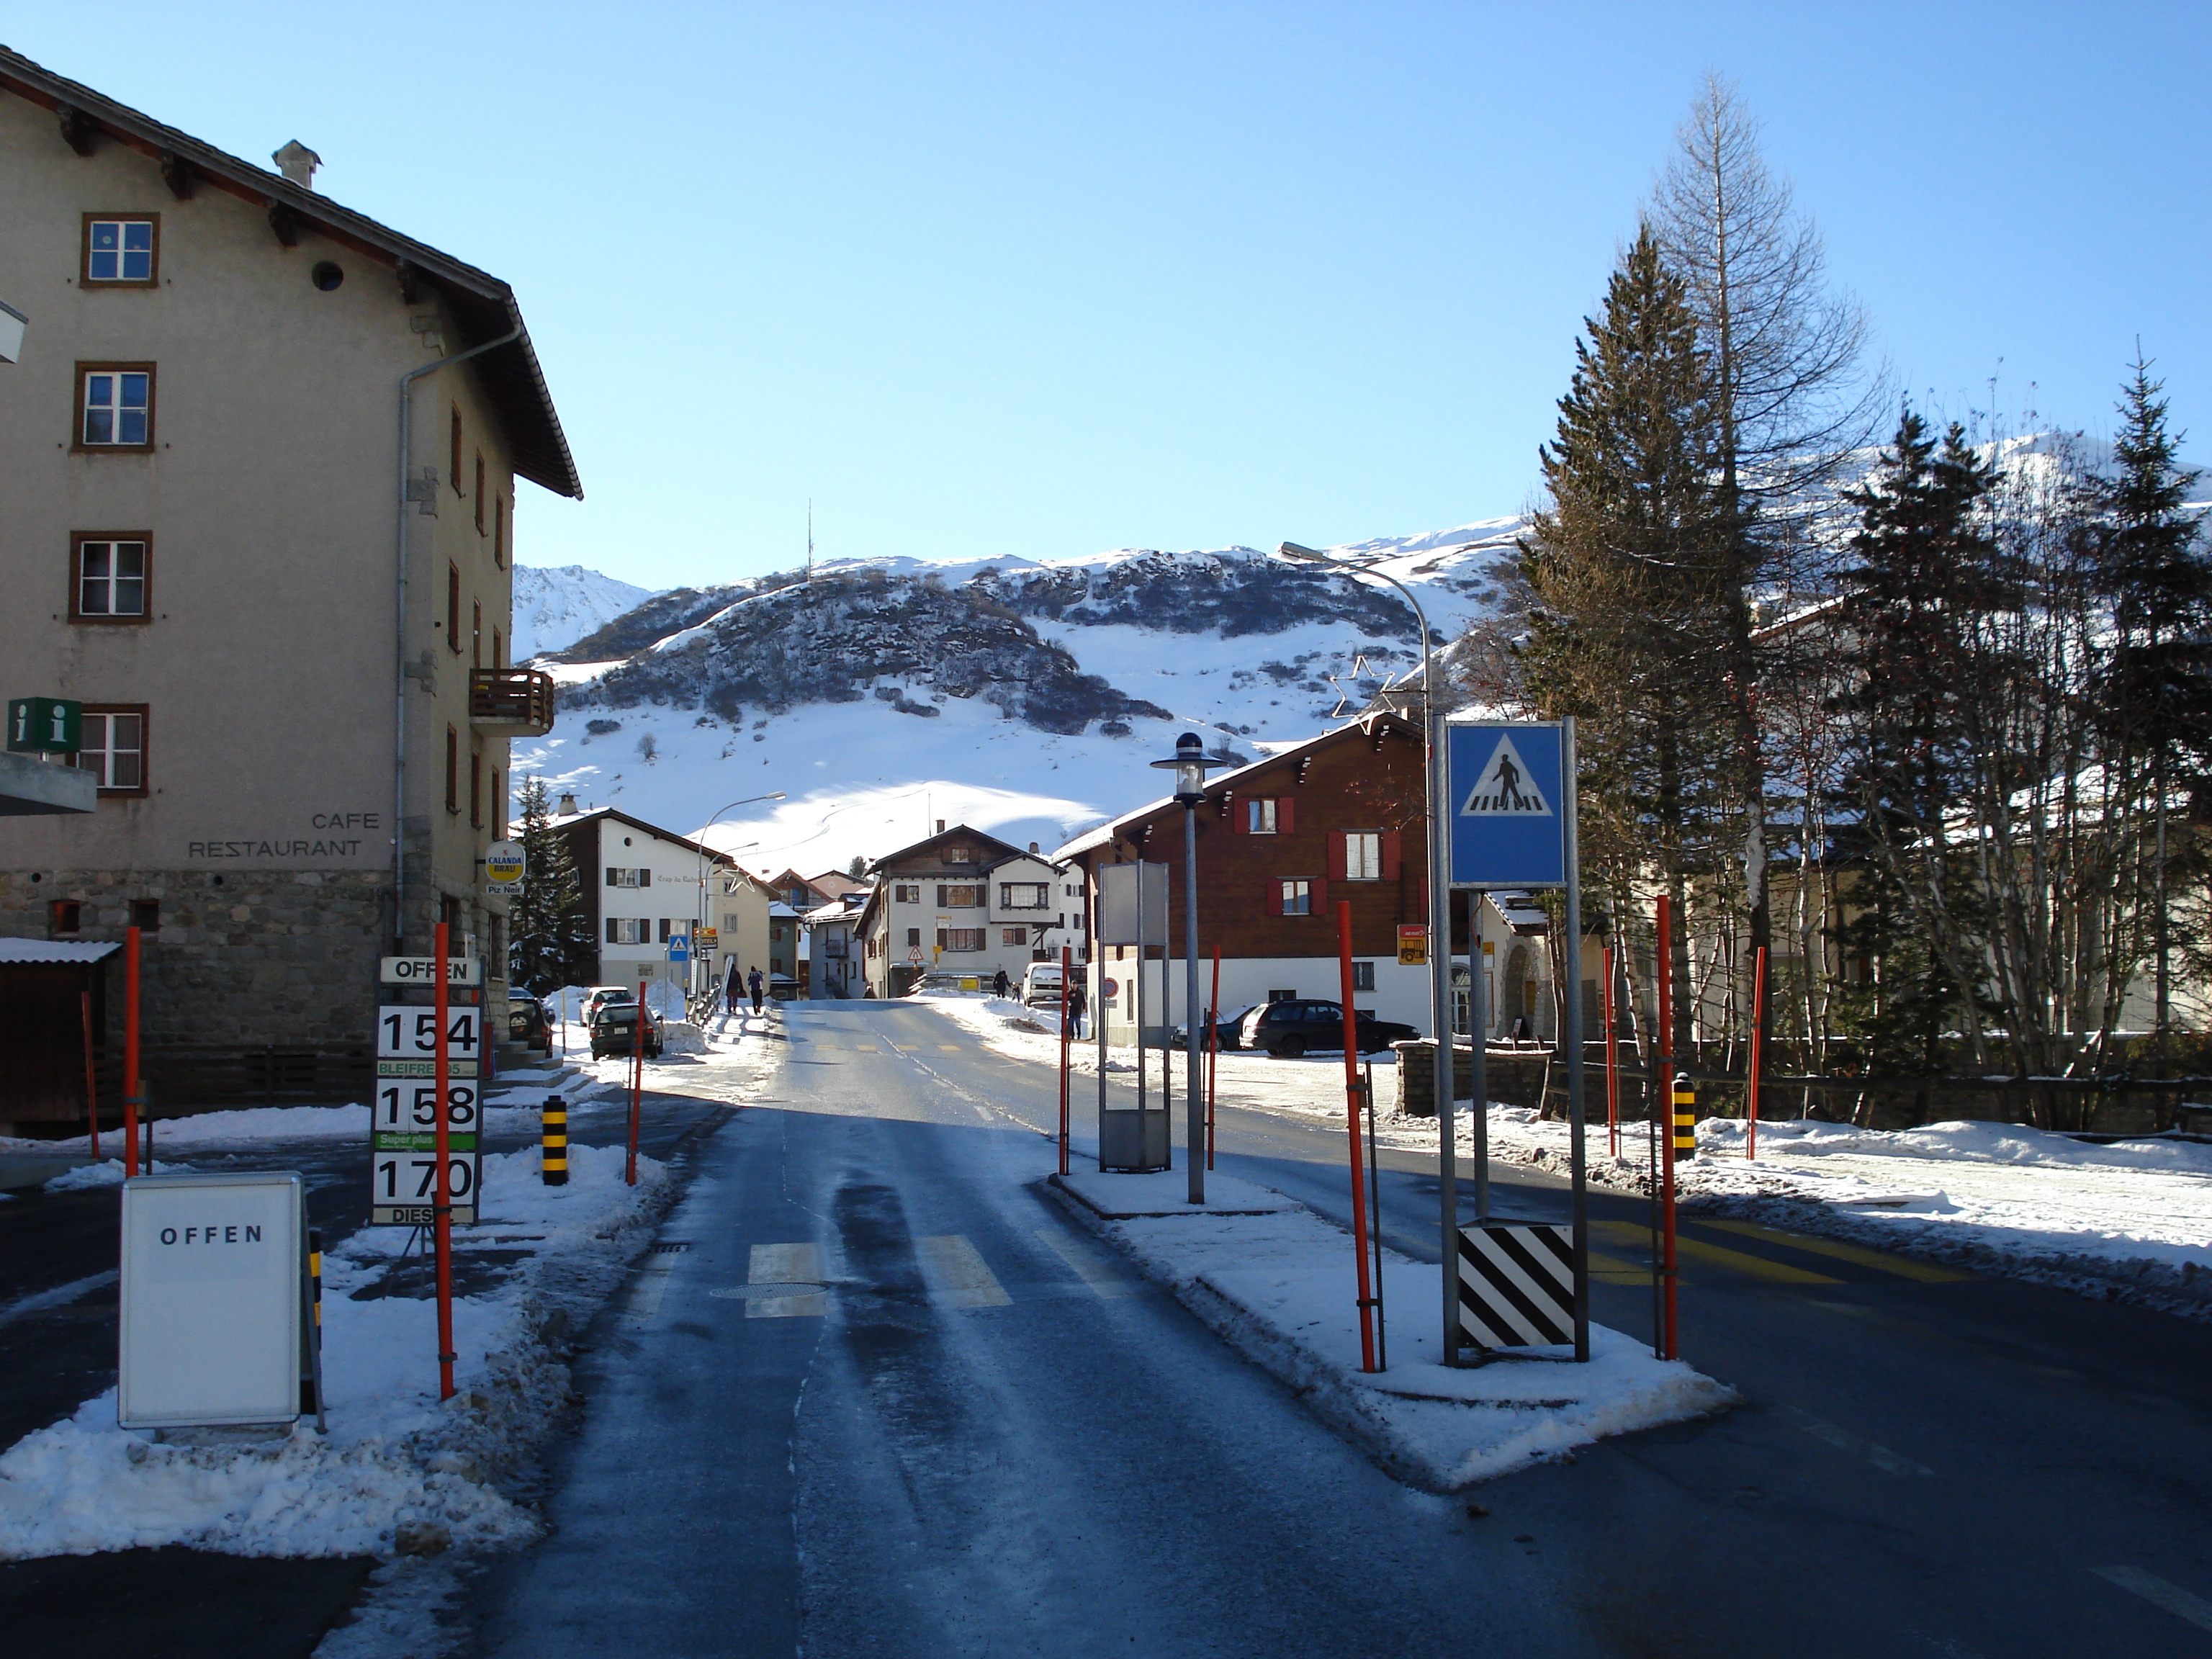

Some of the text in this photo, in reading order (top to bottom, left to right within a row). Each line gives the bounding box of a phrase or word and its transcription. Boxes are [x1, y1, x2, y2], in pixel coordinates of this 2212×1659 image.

[16, 704, 27, 742] i
[50, 705, 67, 742] i
[313, 814, 379, 829] CAFE
[189, 840, 361, 858] RESTAURANT
[384, 1014, 477, 1051] 154
[379, 1064, 436, 1075] BLEIFRE
[382, 1087, 475, 1125] 158
[380, 1135, 433, 1145] Super plus
[379, 1159, 472, 1198] 170
[392, 1209, 454, 1223] DIES
[160, 1226, 261, 1246] OFFEN
